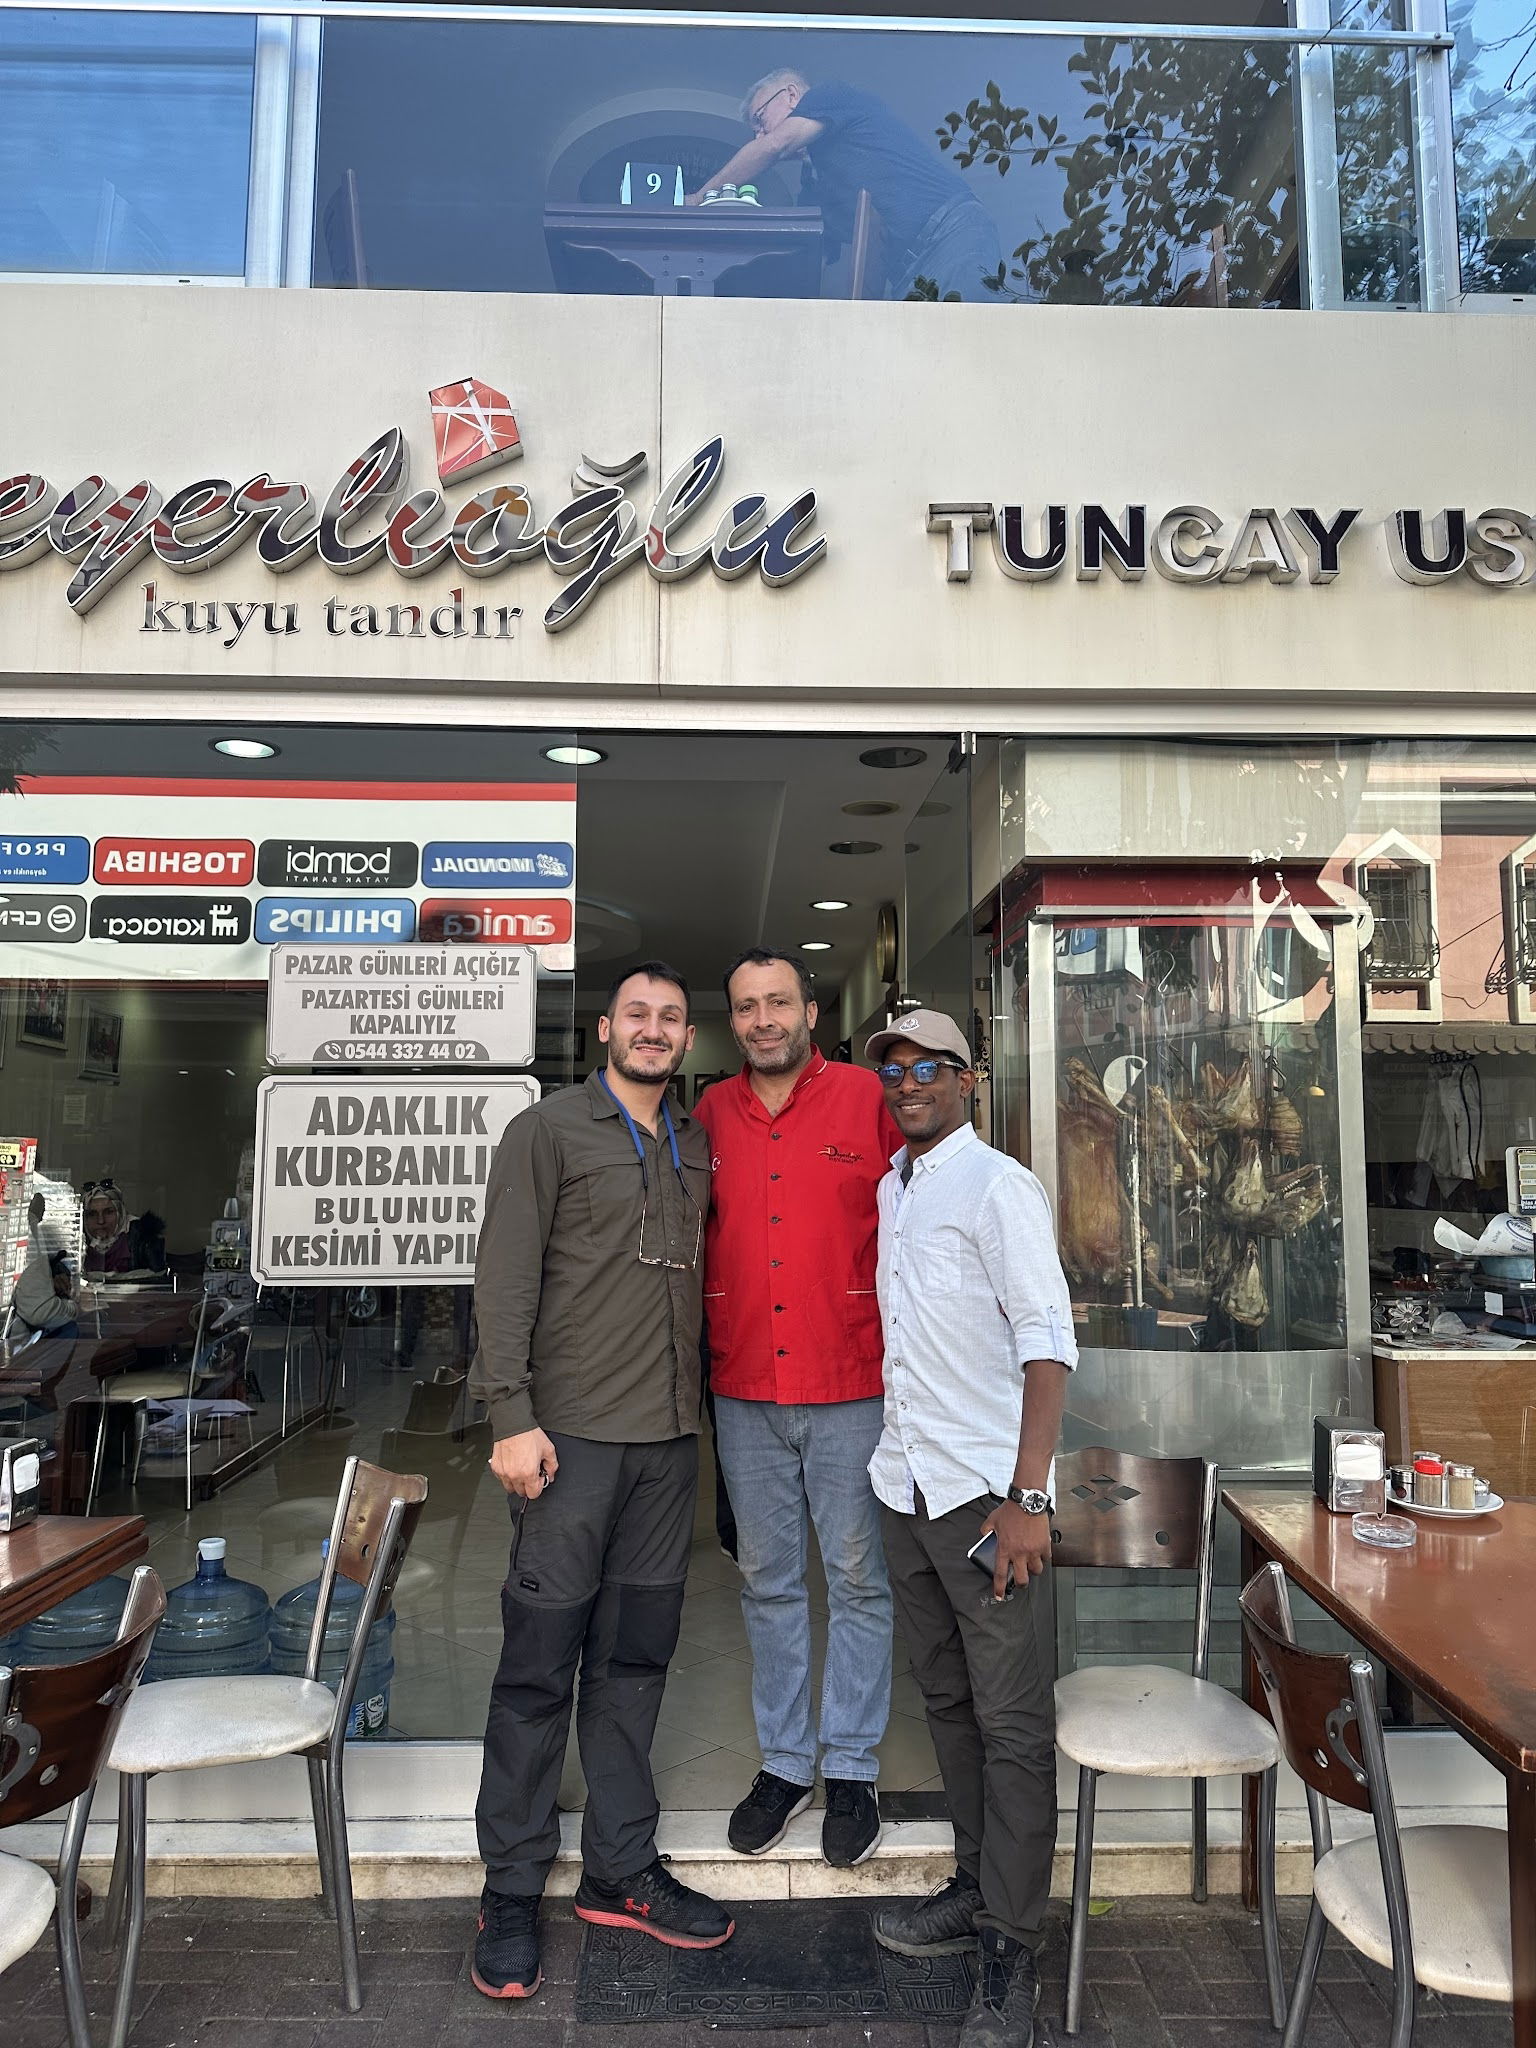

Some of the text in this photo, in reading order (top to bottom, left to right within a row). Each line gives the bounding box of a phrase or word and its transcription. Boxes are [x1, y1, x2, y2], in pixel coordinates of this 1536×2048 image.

[646, 172, 662, 195] 9
[925, 502, 1536, 587] TUNCAY US
[139, 582, 523, 649] kuyu tandır
[285, 950, 521, 982] PAZAR GÜNLERİ AÇIĞIZ
[301, 983, 505, 1010] PAZARTESİ GÜNLERİ
[349, 1014, 456, 1036] KAPALIYIZ
[344, 1042, 477, 1060] 0544 332 44 02
[305, 1095, 490, 1137] ADAKLIK
[313, 1195, 478, 1226] BULUNUR
[270, 1227, 382, 1267] KESİMİ
